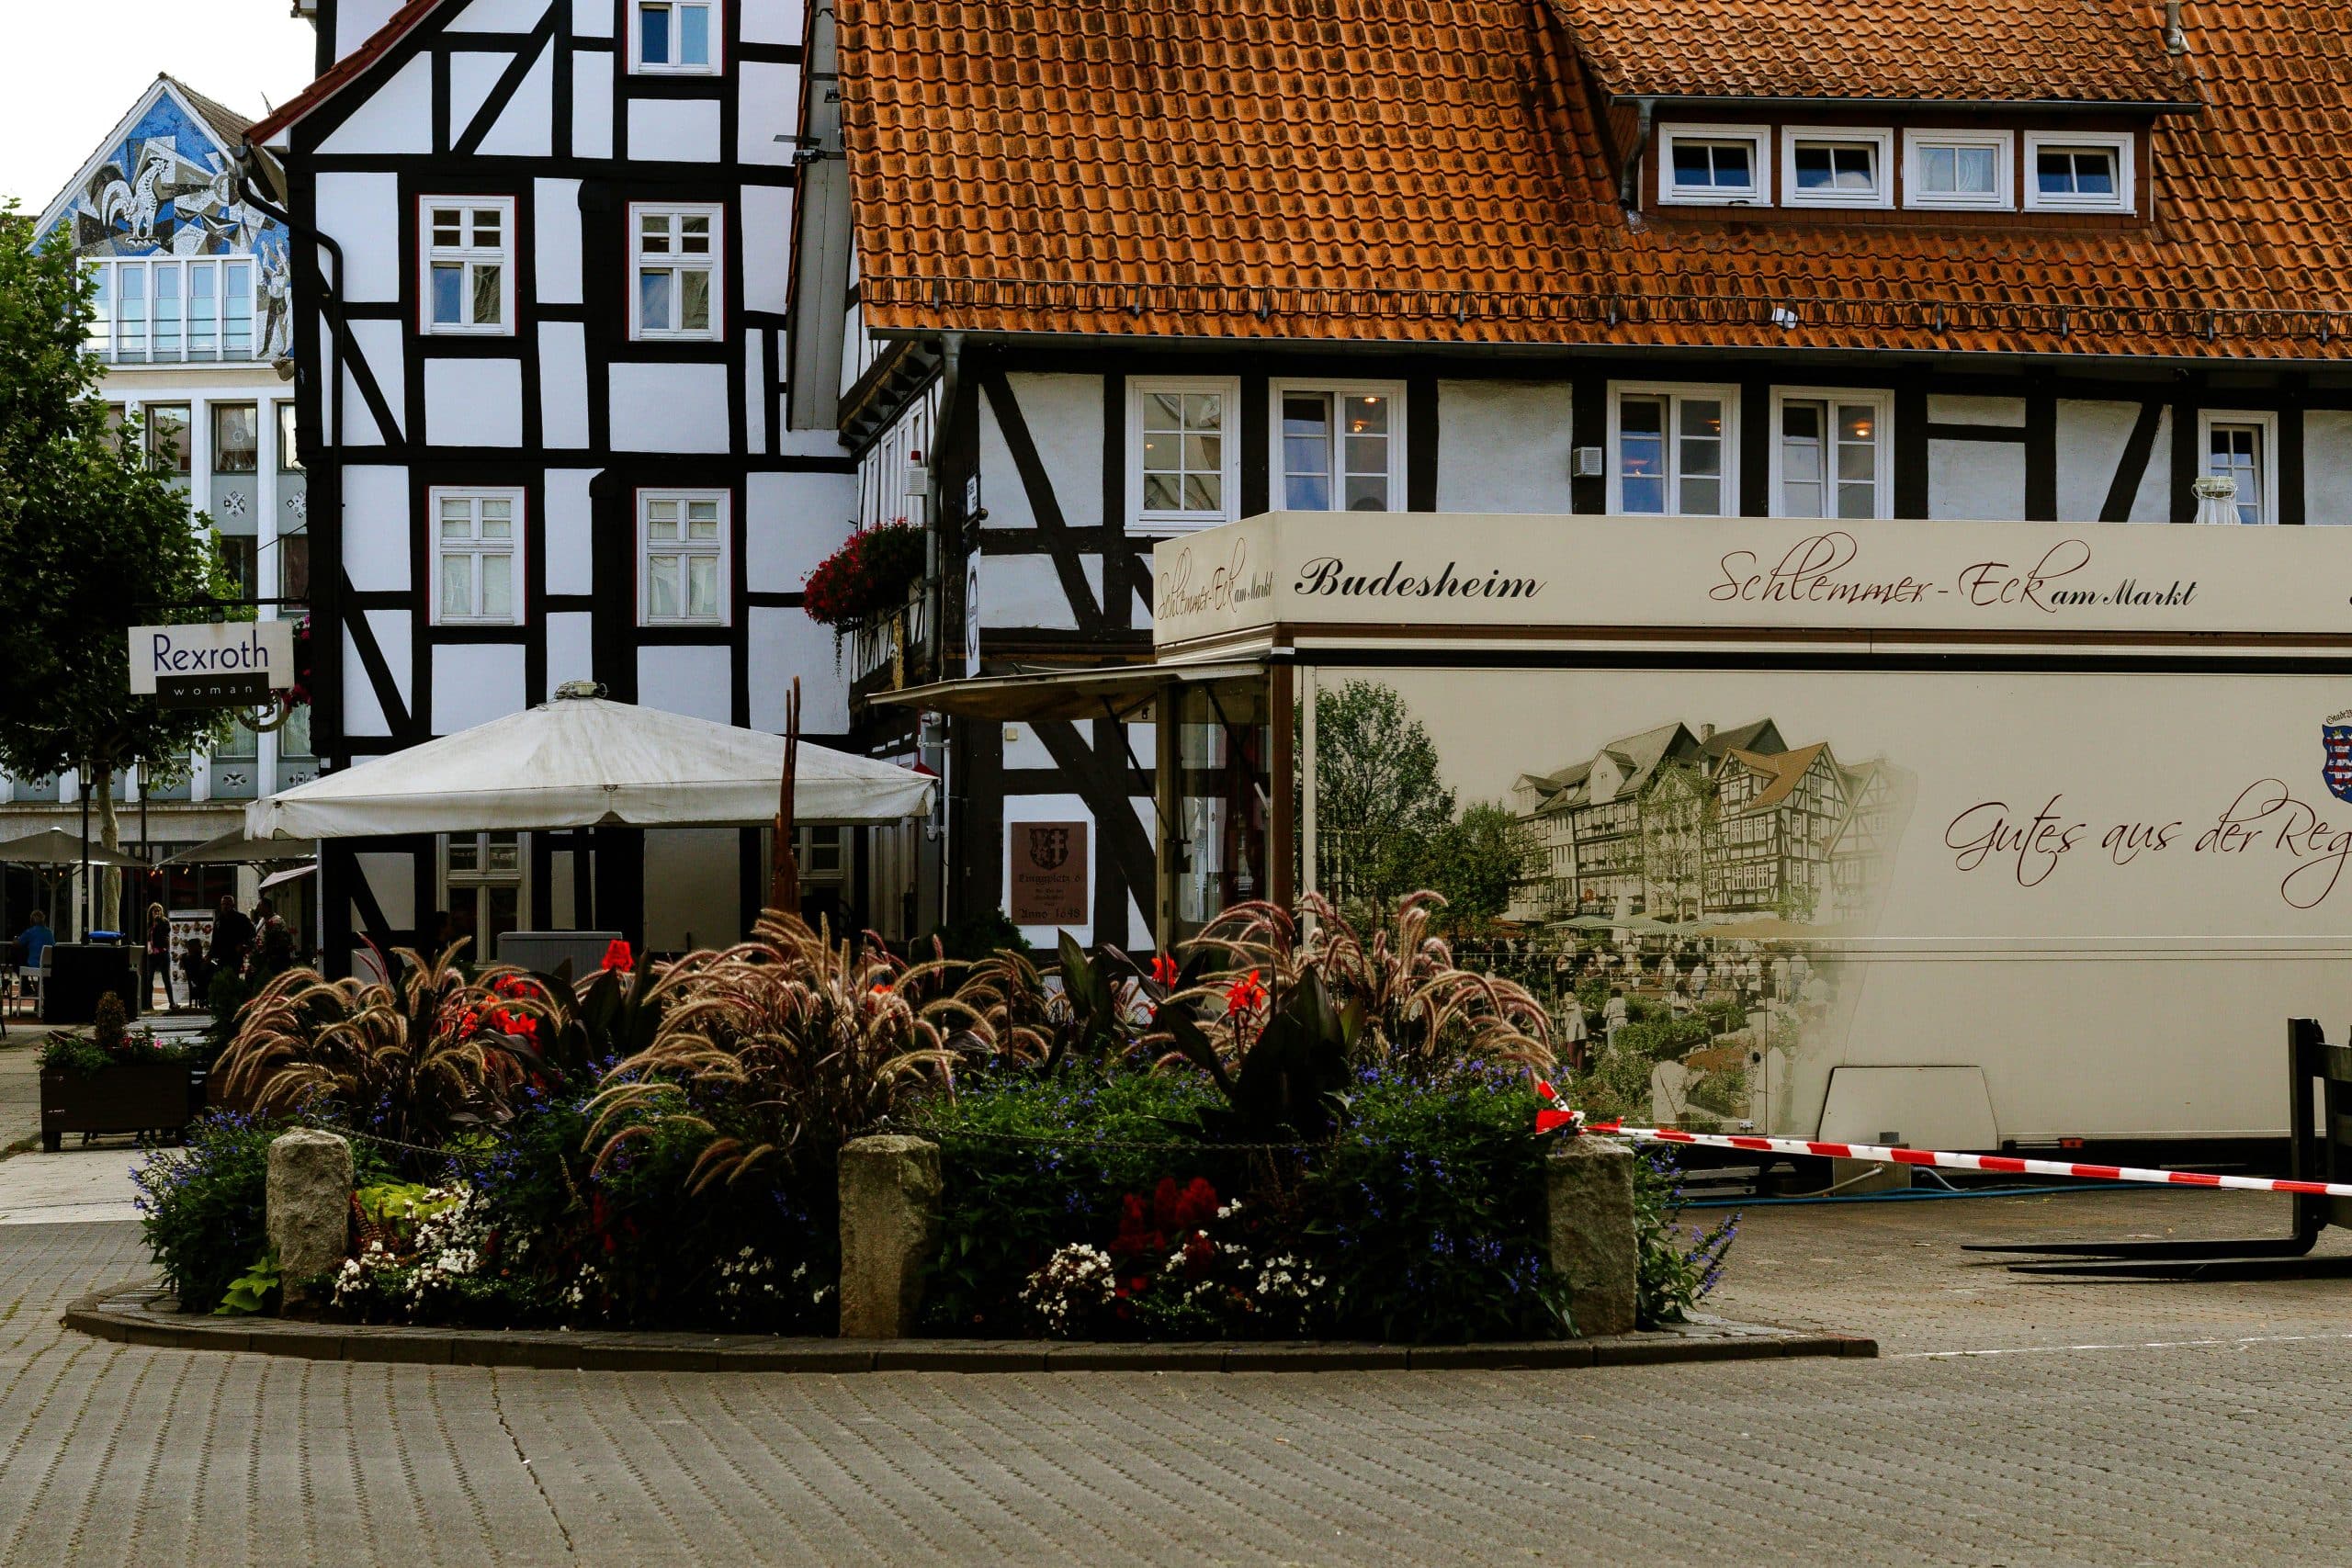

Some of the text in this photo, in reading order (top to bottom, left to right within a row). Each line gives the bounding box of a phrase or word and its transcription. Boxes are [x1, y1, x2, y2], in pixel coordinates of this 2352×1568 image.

[1234, 586, 1247, 603] am
[1294, 557, 1547, 599] Budesheim
[2051, 585, 2098, 607] am
[2101, 579, 2199, 607] Markt
[153, 628, 269, 671] Rexroth
[174, 684, 253, 696] woman
[1944, 793, 2087, 887] Gutes
[2101, 820, 2184, 866] aus
[2194, 778, 2289, 854] der
